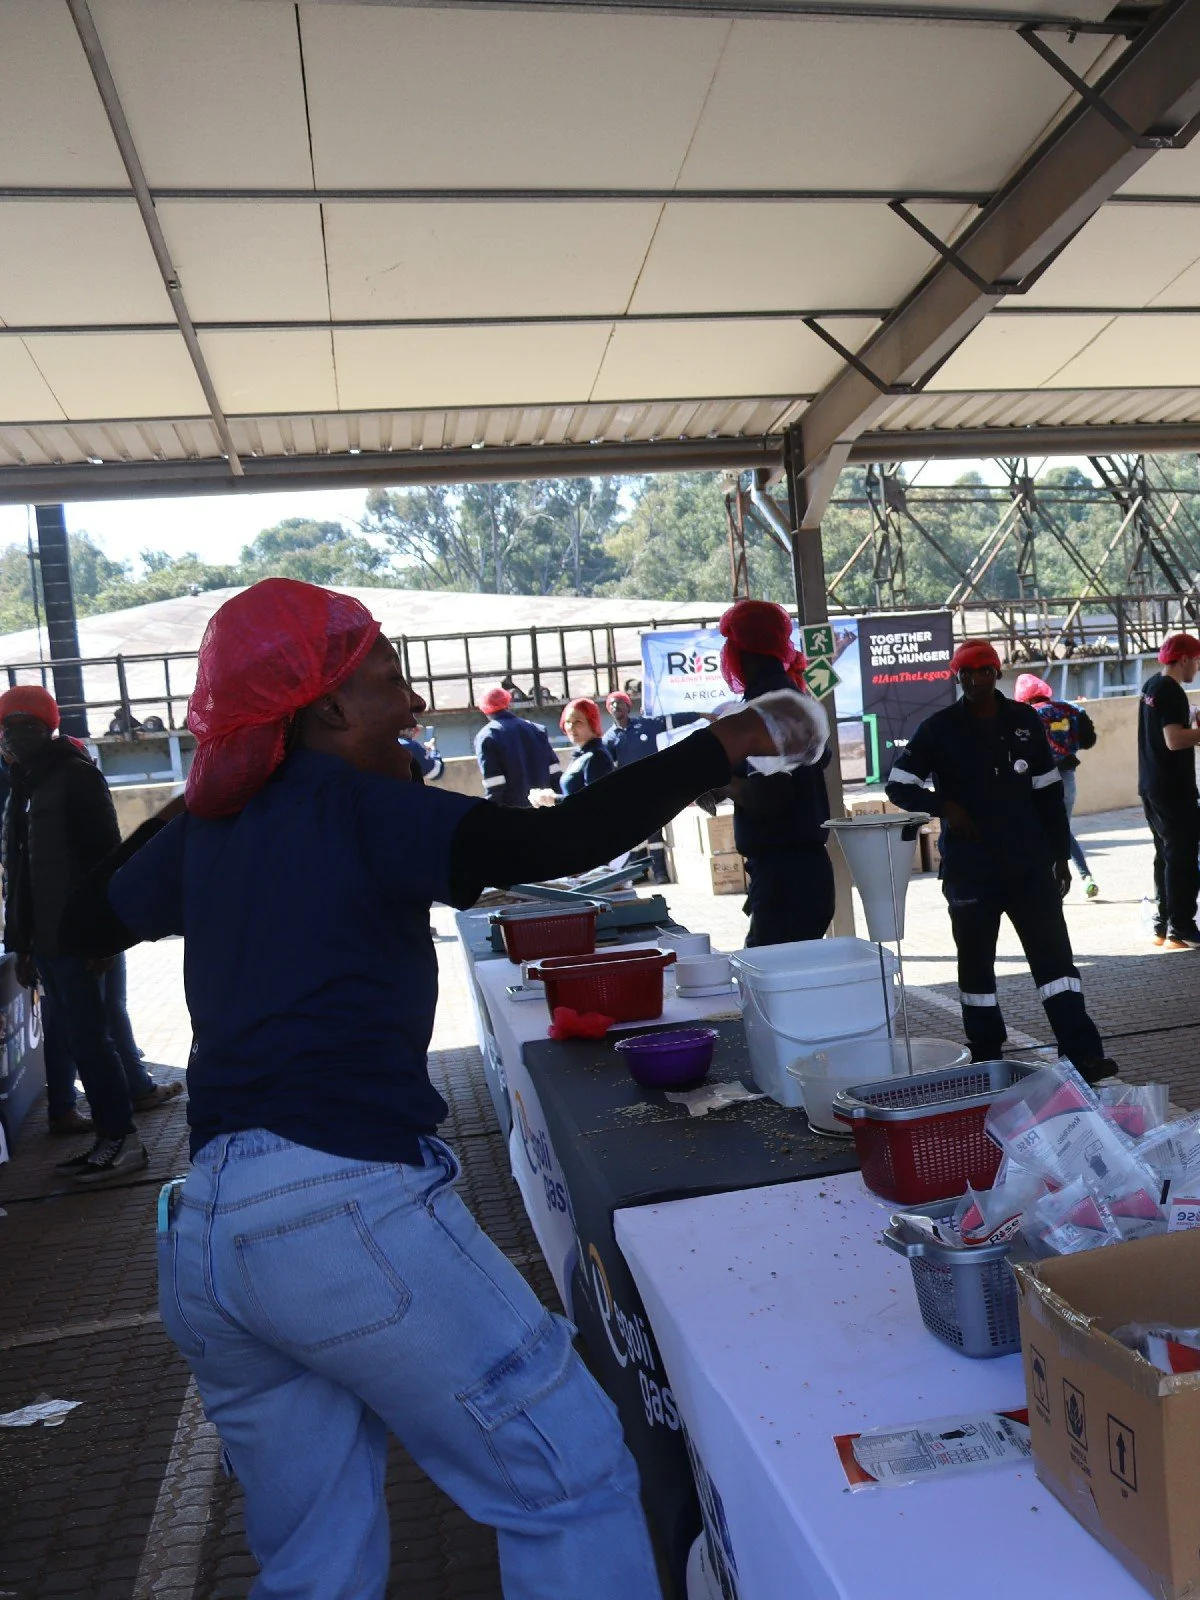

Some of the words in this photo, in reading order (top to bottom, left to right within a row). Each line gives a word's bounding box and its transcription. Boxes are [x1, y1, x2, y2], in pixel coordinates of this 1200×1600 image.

[869, 631, 932, 645] TOGETHER
[870, 645, 891, 656] WE
[893, 642, 919, 654] CAN
[667, 650, 718, 675] Ris
[871, 655, 896, 667] END
[898, 650, 950, 664] HUNGER!
[669, 675, 703, 684] AGAINST
[872, 669, 952, 685] #IAmTheLegacy
[684, 689, 726, 700] AFRICA
[543, 1173, 567, 1213] gas
[613, 1300, 656, 1371] egoli
[639, 1369, 679, 1431] gas
